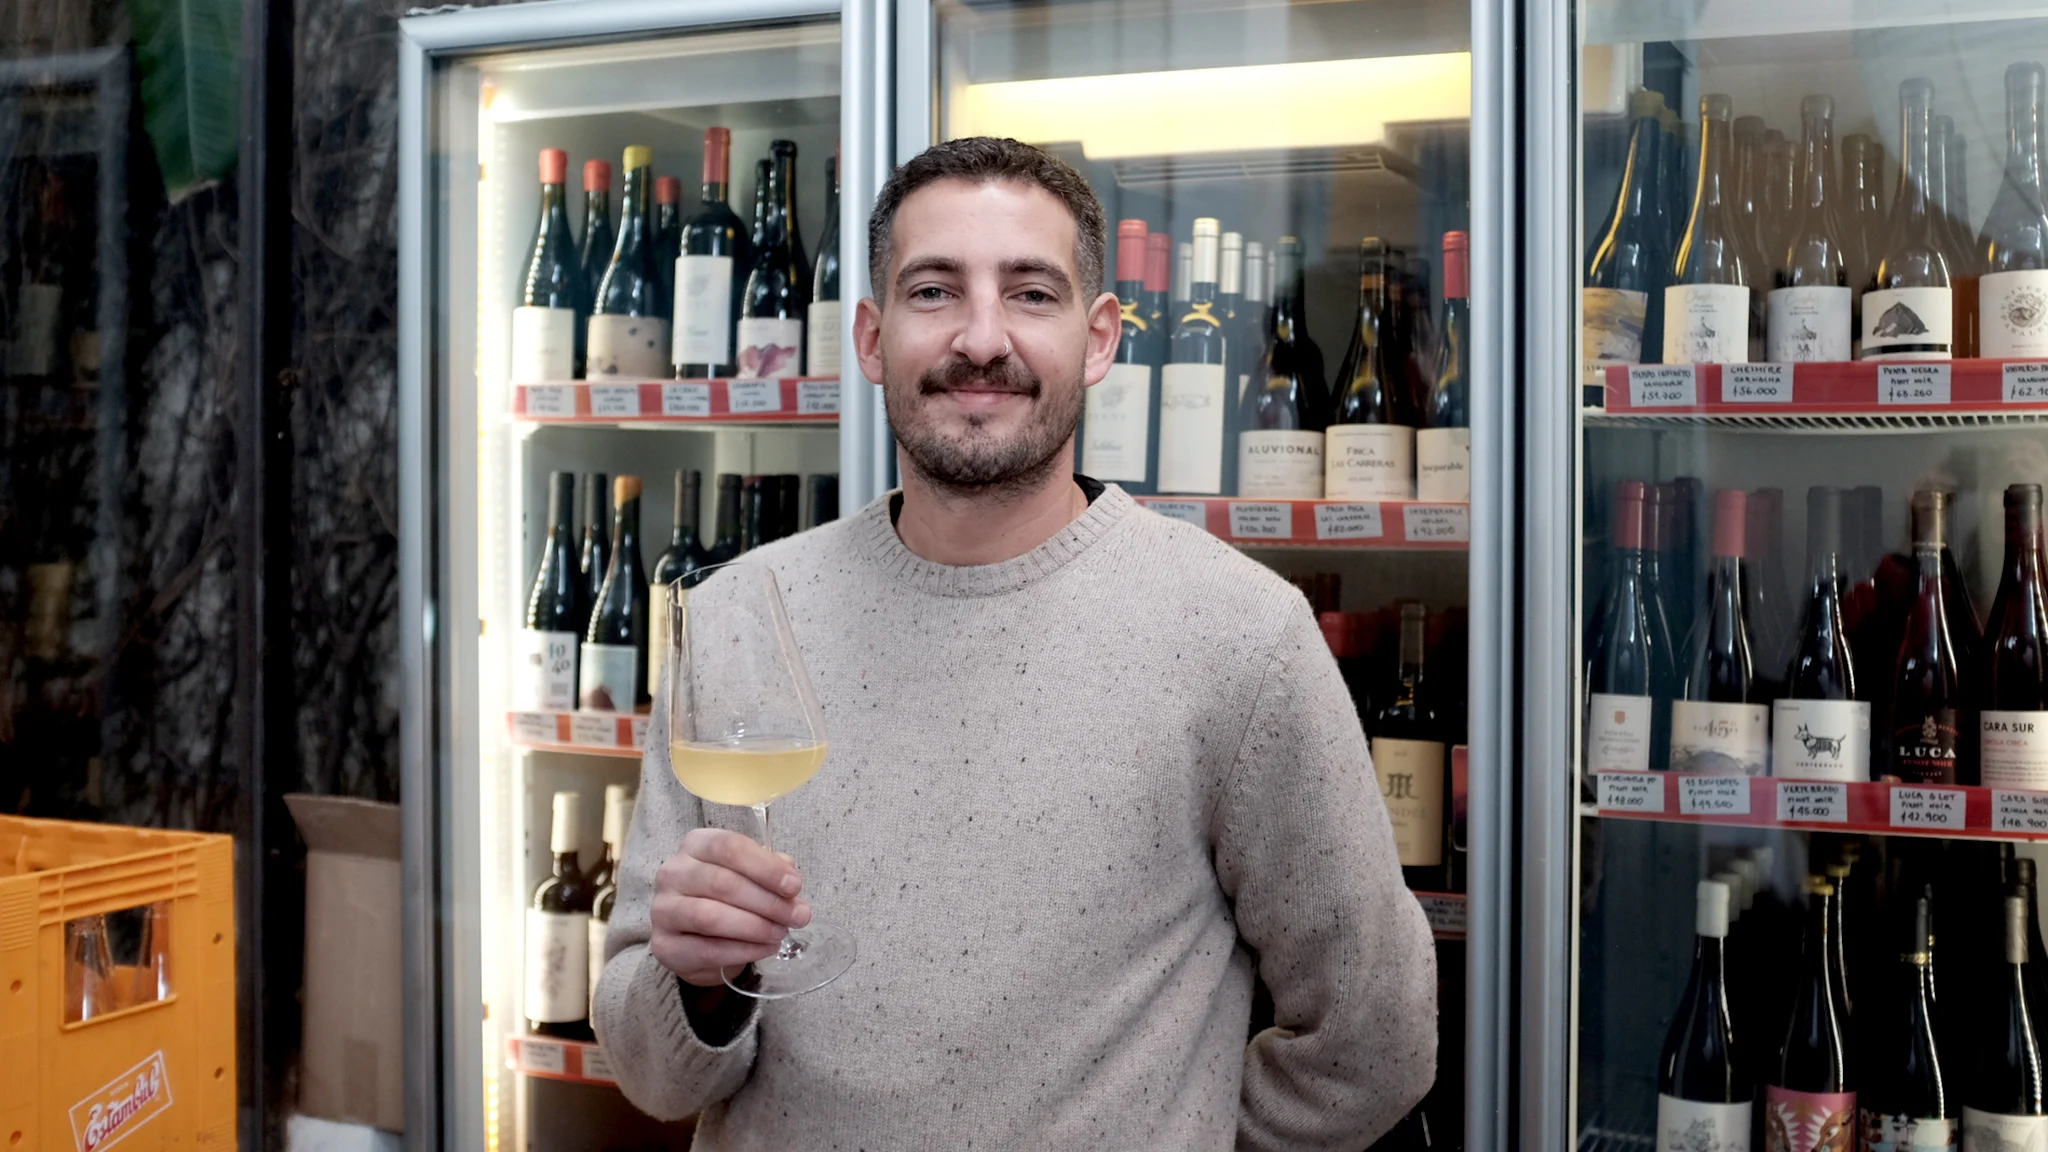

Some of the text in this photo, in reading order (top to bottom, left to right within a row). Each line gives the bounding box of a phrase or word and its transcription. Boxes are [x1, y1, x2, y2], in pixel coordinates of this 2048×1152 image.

[1247, 444, 1320, 456] ALUVIONAL
[1346, 446, 1375, 455] FINCA
[1347, 458, 1395, 469] CARRERAS
[1983, 720, 2034, 733] CARA SUR
[1899, 745, 1957, 759] LUCA
[1783, 785, 1839, 794] VERTEBRADO
[1898, 791, 1923, 800] LUCA
[1939, 793, 1955, 801] LOT
[2000, 794, 2026, 803] CARA
